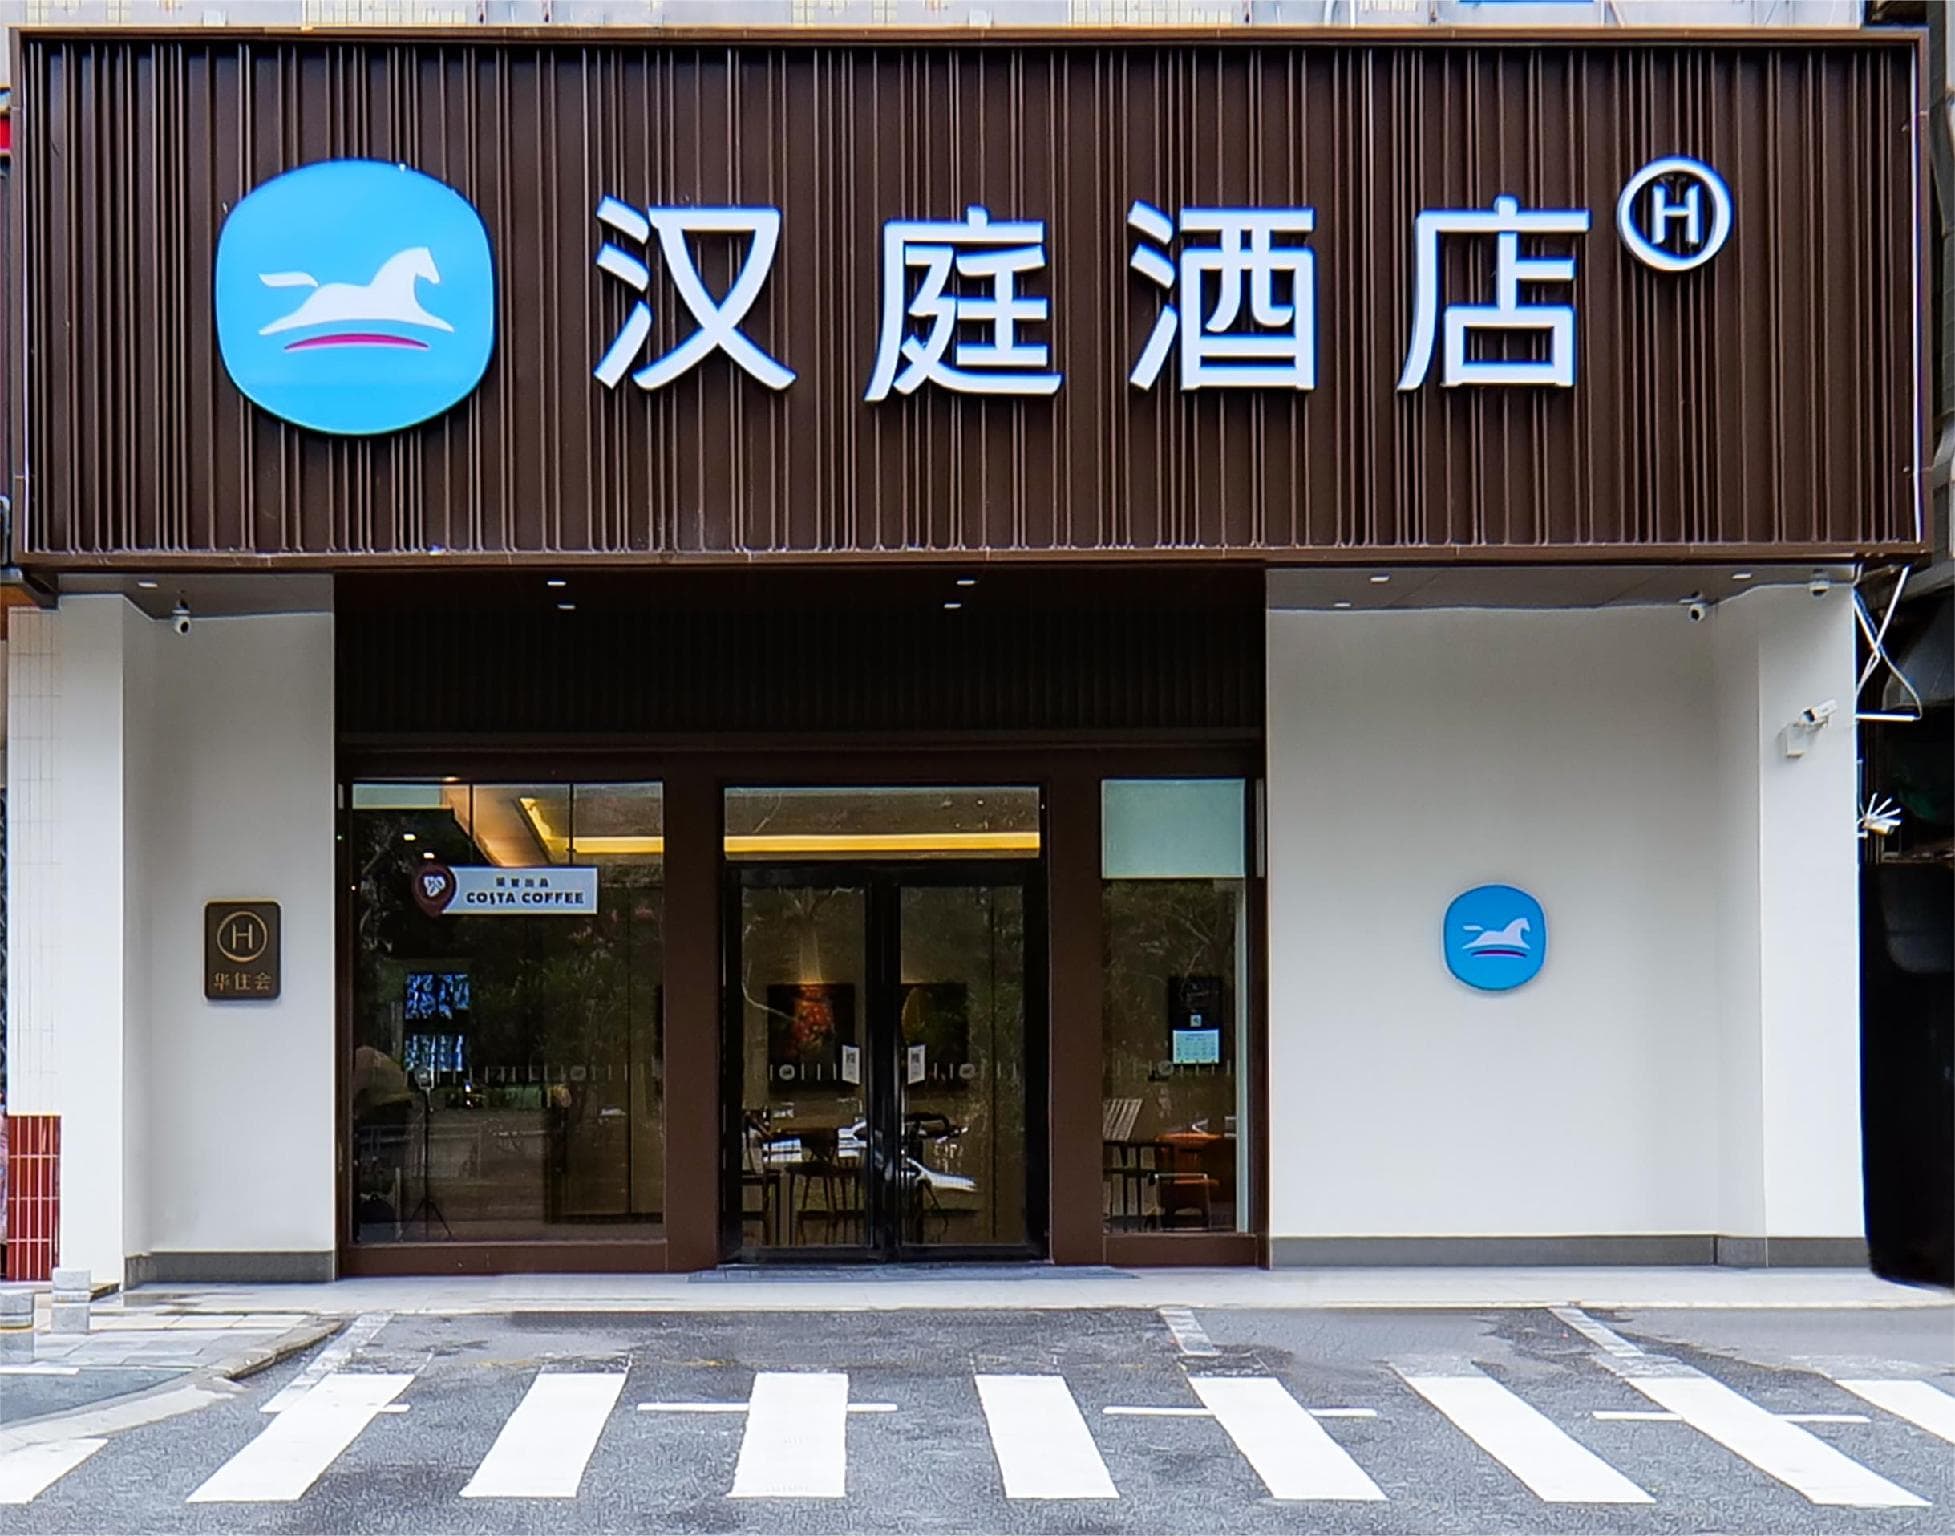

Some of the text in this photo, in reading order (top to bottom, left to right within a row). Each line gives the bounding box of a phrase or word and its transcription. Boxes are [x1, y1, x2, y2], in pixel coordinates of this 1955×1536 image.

[593, 194, 1591, 401] 汉庭酒店
[466, 892, 584, 905] COSTA COFFEE
[213, 972, 273, 991] 华住会
